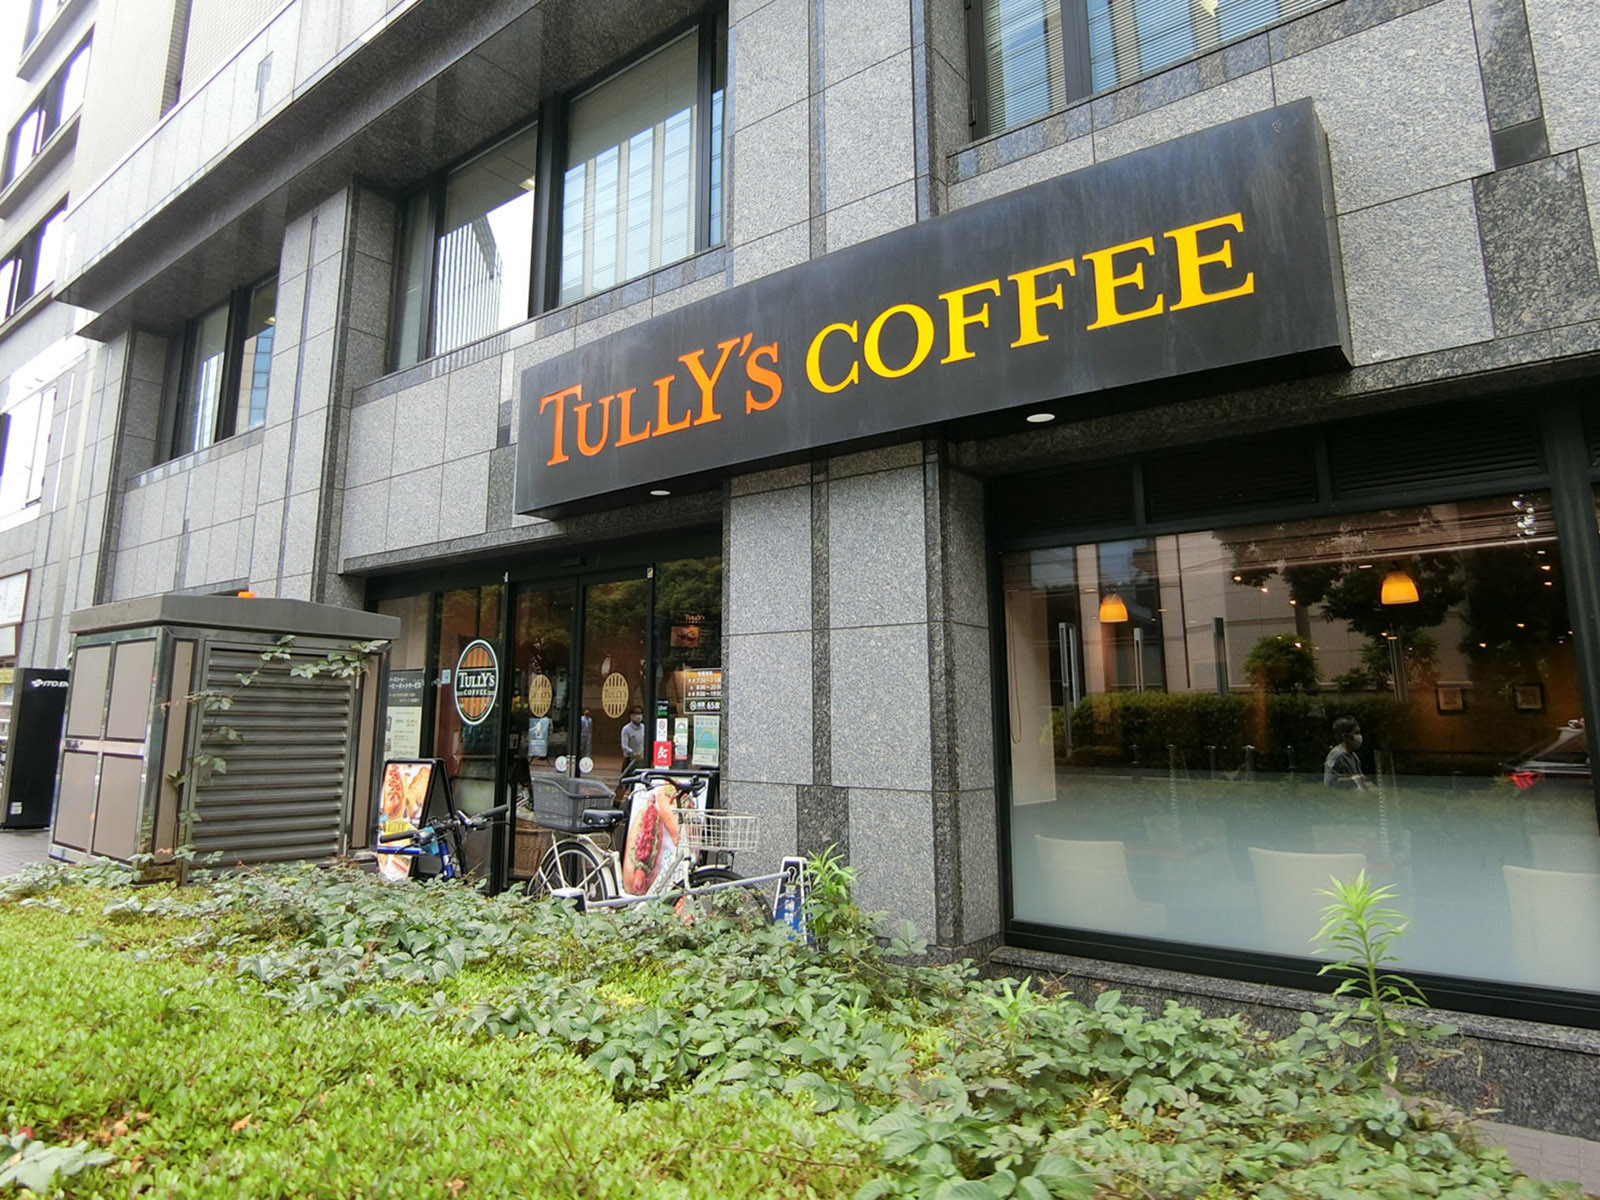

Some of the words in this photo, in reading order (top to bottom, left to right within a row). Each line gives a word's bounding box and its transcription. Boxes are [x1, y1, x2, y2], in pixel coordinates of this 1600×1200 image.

[538, 332, 784, 467] TULLY'S
[805, 212, 1256, 394] COFFEE
[459, 672, 495, 688] TULLY'S
